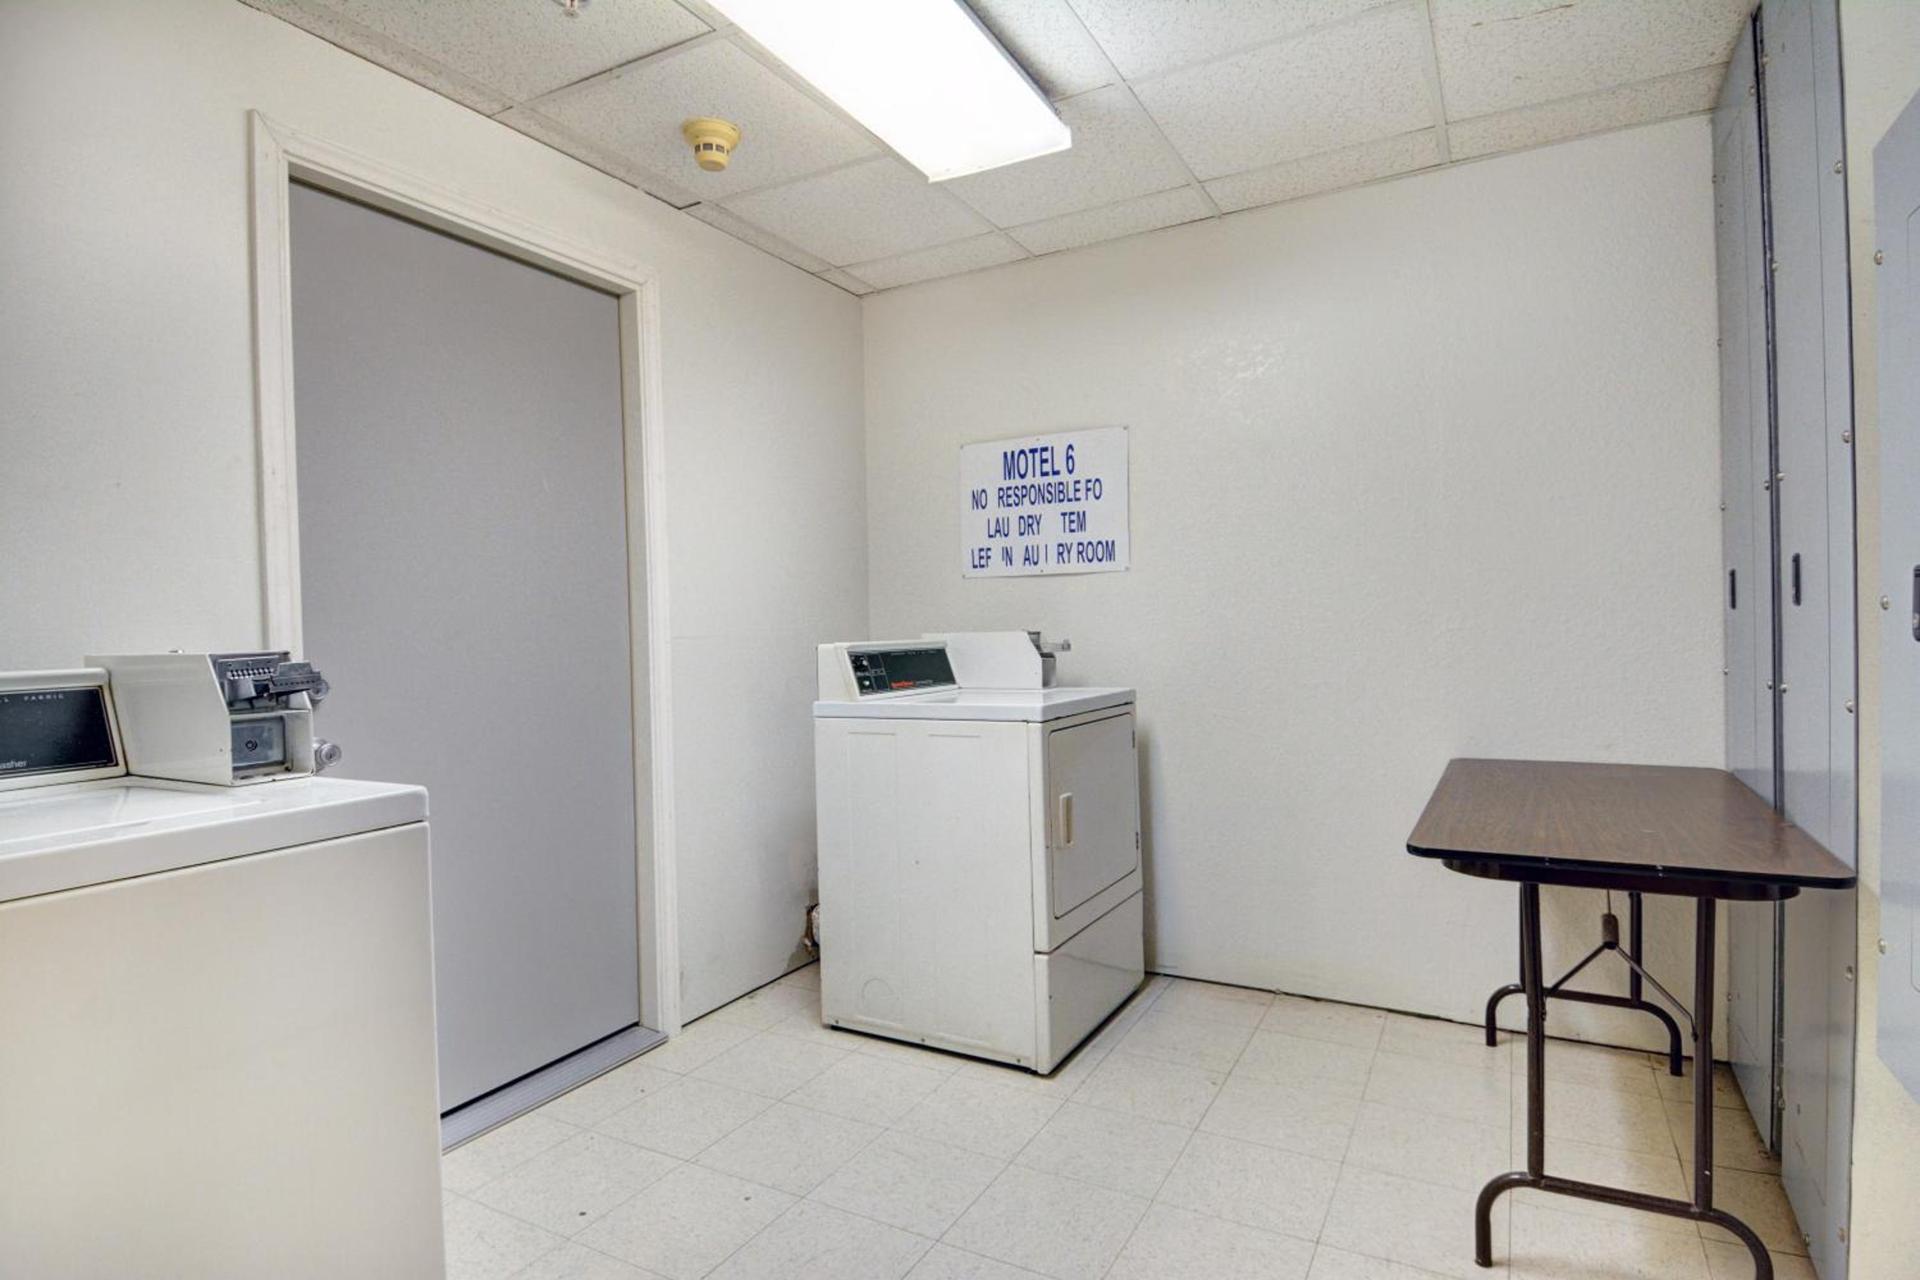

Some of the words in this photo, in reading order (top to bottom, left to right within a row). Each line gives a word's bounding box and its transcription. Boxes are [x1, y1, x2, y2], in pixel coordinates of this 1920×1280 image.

[1003, 446, 1060, 480] MOTEL
[1065, 443, 1075, 475] 6
[971, 489, 988, 510] NO
[997, 479, 1082, 508] RESPONSIBLE
[1085, 478, 1103, 500] FO
[1060, 511, 1087, 533] TEM
[971, 547, 992, 569] LEF
[1077, 540, 1116, 563] ROOM
